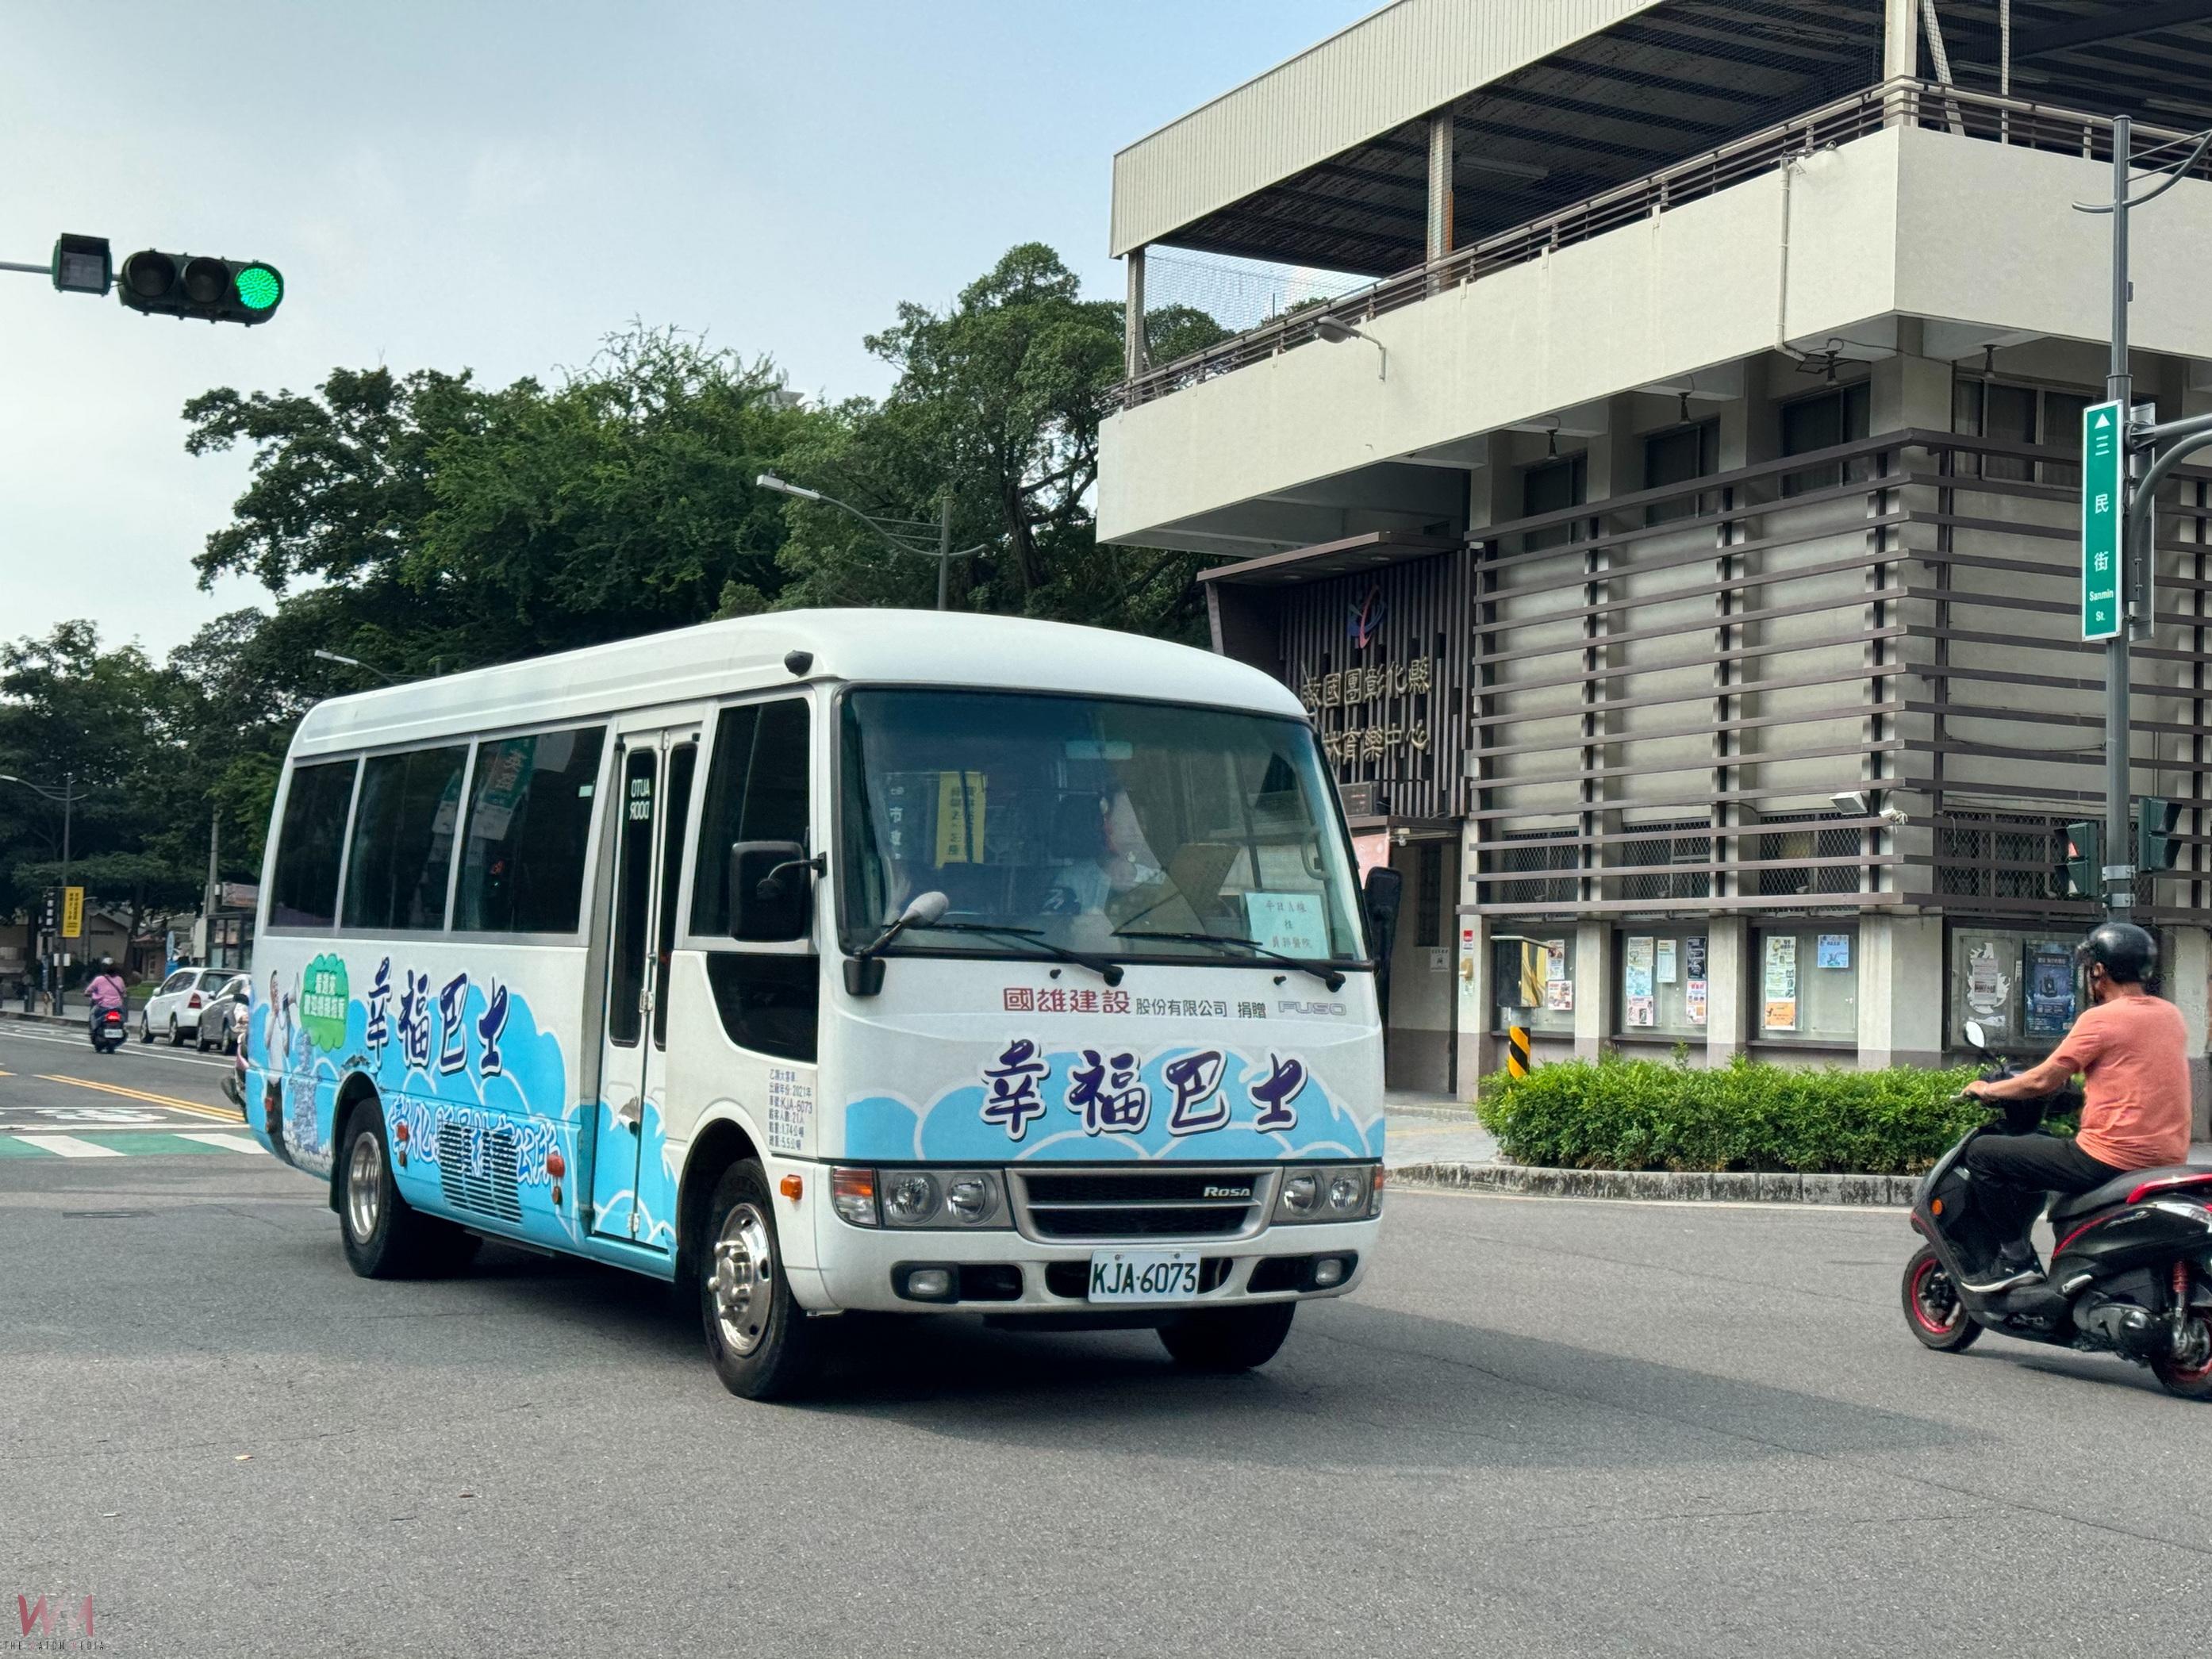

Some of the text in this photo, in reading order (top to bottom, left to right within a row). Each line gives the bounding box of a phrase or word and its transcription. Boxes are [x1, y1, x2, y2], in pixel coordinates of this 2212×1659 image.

[2094, 434, 2110, 572] 三民街
[2089, 589, 2114, 601] Sanmin
[2095, 610, 2106, 621] St.
[1303, 656, 1431, 709] 救國團彰化縣
[367, 956, 508, 1071] 幸福巴士
[1237, 1001, 1267, 1019] 捐贈
[1277, 1000, 1347, 1016] FUSO
[984, 1038, 1304, 1134] 幸福巴士
